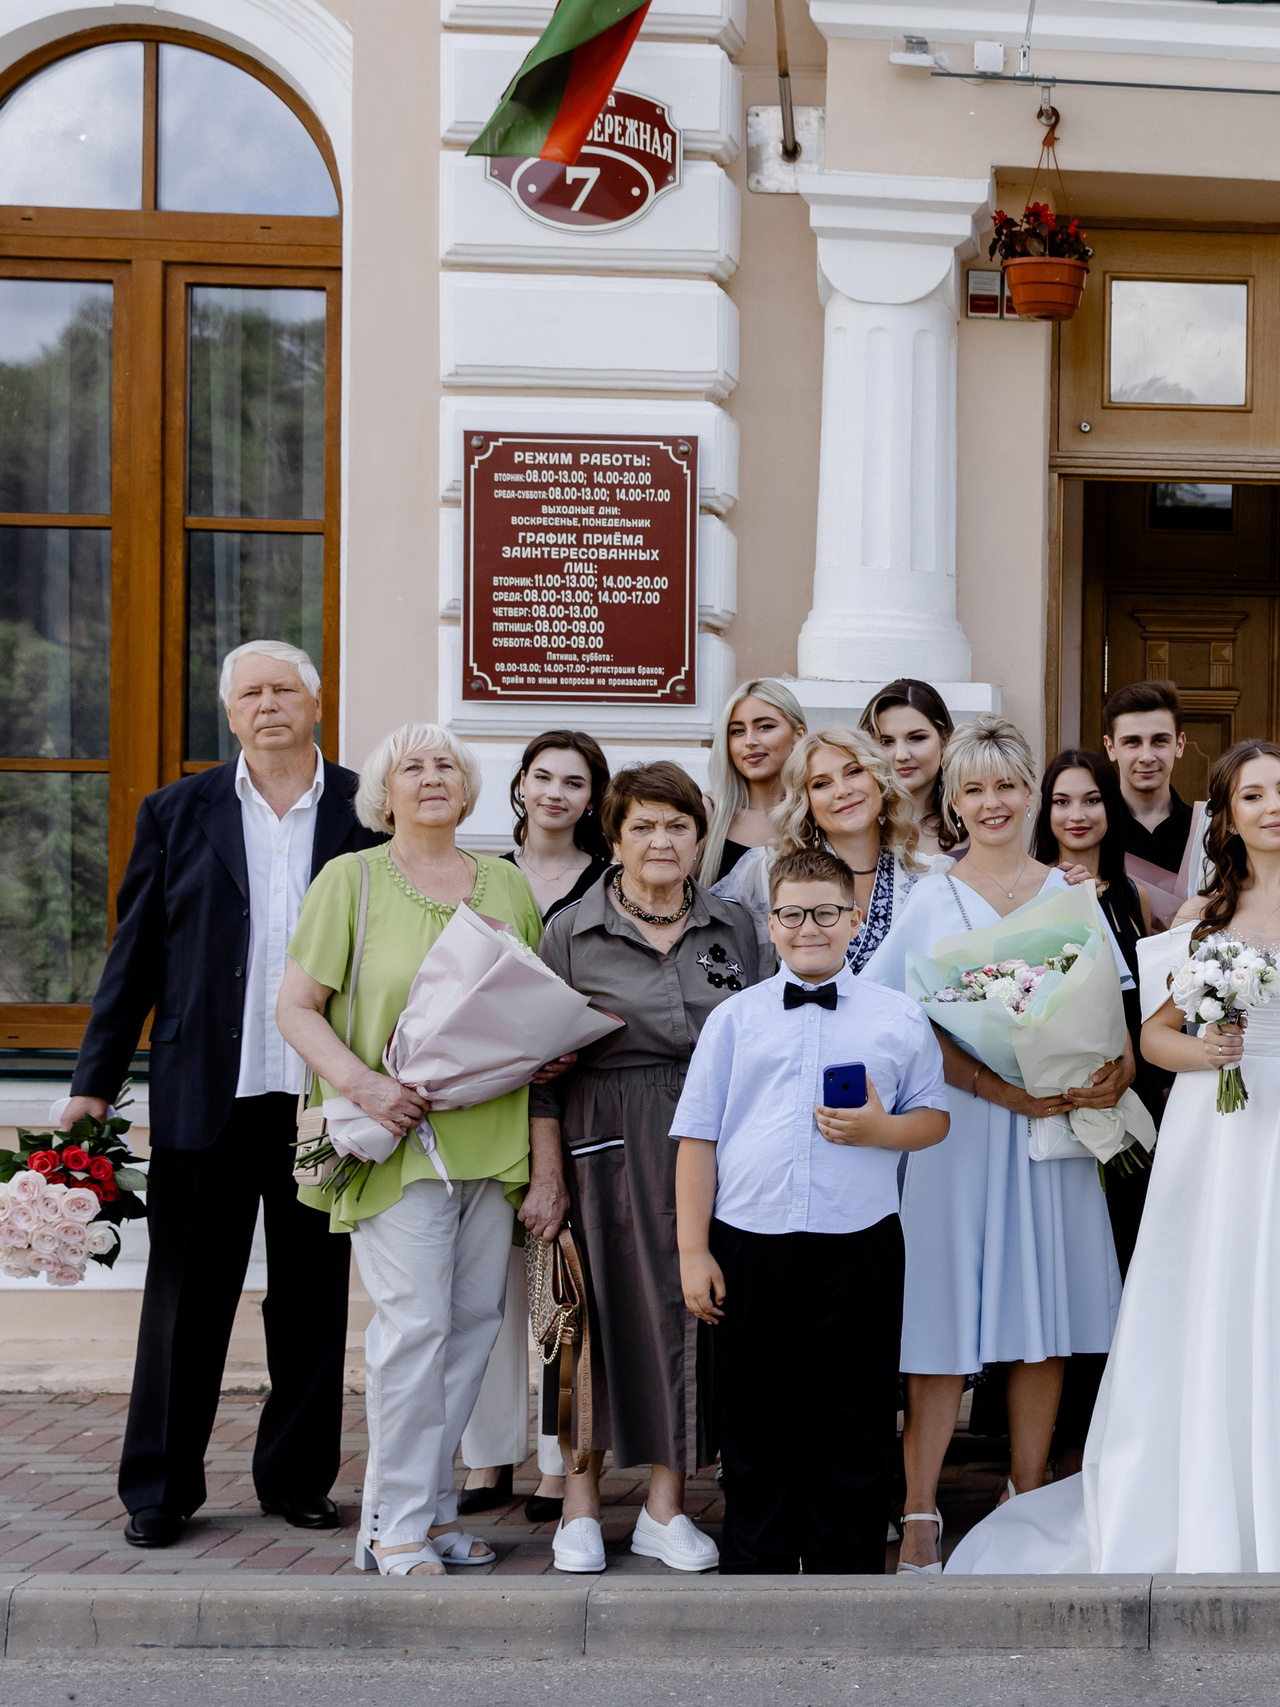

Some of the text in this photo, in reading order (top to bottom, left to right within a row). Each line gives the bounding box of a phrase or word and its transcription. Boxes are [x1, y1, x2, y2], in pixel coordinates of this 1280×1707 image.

[565, 166, 601, 212] 7
[514, 451, 650, 466] РЕЖИМ РАБОТЫ:
[494, 470, 651, 485] ВТОРНИК: 08.00-13.00; 14.00-20.00
[494, 487, 670, 502] СРЕДА-СУББОТА: 08.00-13.00; 14.00-17.00
[541, 505, 620, 515] ВЫХОДНЫЕ ДНИ:
[511, 516, 650, 527] ВОСКРЕСЕНЬЕ, ПОНЕДЕЛЬНИК
[518, 532, 643, 546] ГРАФИК ПРИЁМА
[502, 545, 659, 560] ЗАИНТЕРЕСОВАННЫХ
[563, 562, 597, 576] ЛИЦ:
[493, 574, 668, 590] ВТОРНИК: 11.00-13.00; 14.00-20.00
[493, 589, 660, 605] СРЕДА: 08.00-13.00; 14.00-17.00
[493, 605, 598, 618] ЧЕТВЕРГ: 08.00-13.00
[493, 620, 605, 633] ПЯТНИЦА: 08.00-09.00
[492, 635, 603, 649] СУББОТА: 08.00-09.00
[547, 652, 613, 663] Пятница, суббота:
[495, 663, 541, 673] 09.00-13.00;
[638, 665, 664, 675] браков;
[502, 675, 524, 685] приём
[560, 677, 594, 686] вопросам
[608, 678, 657, 687] производится
